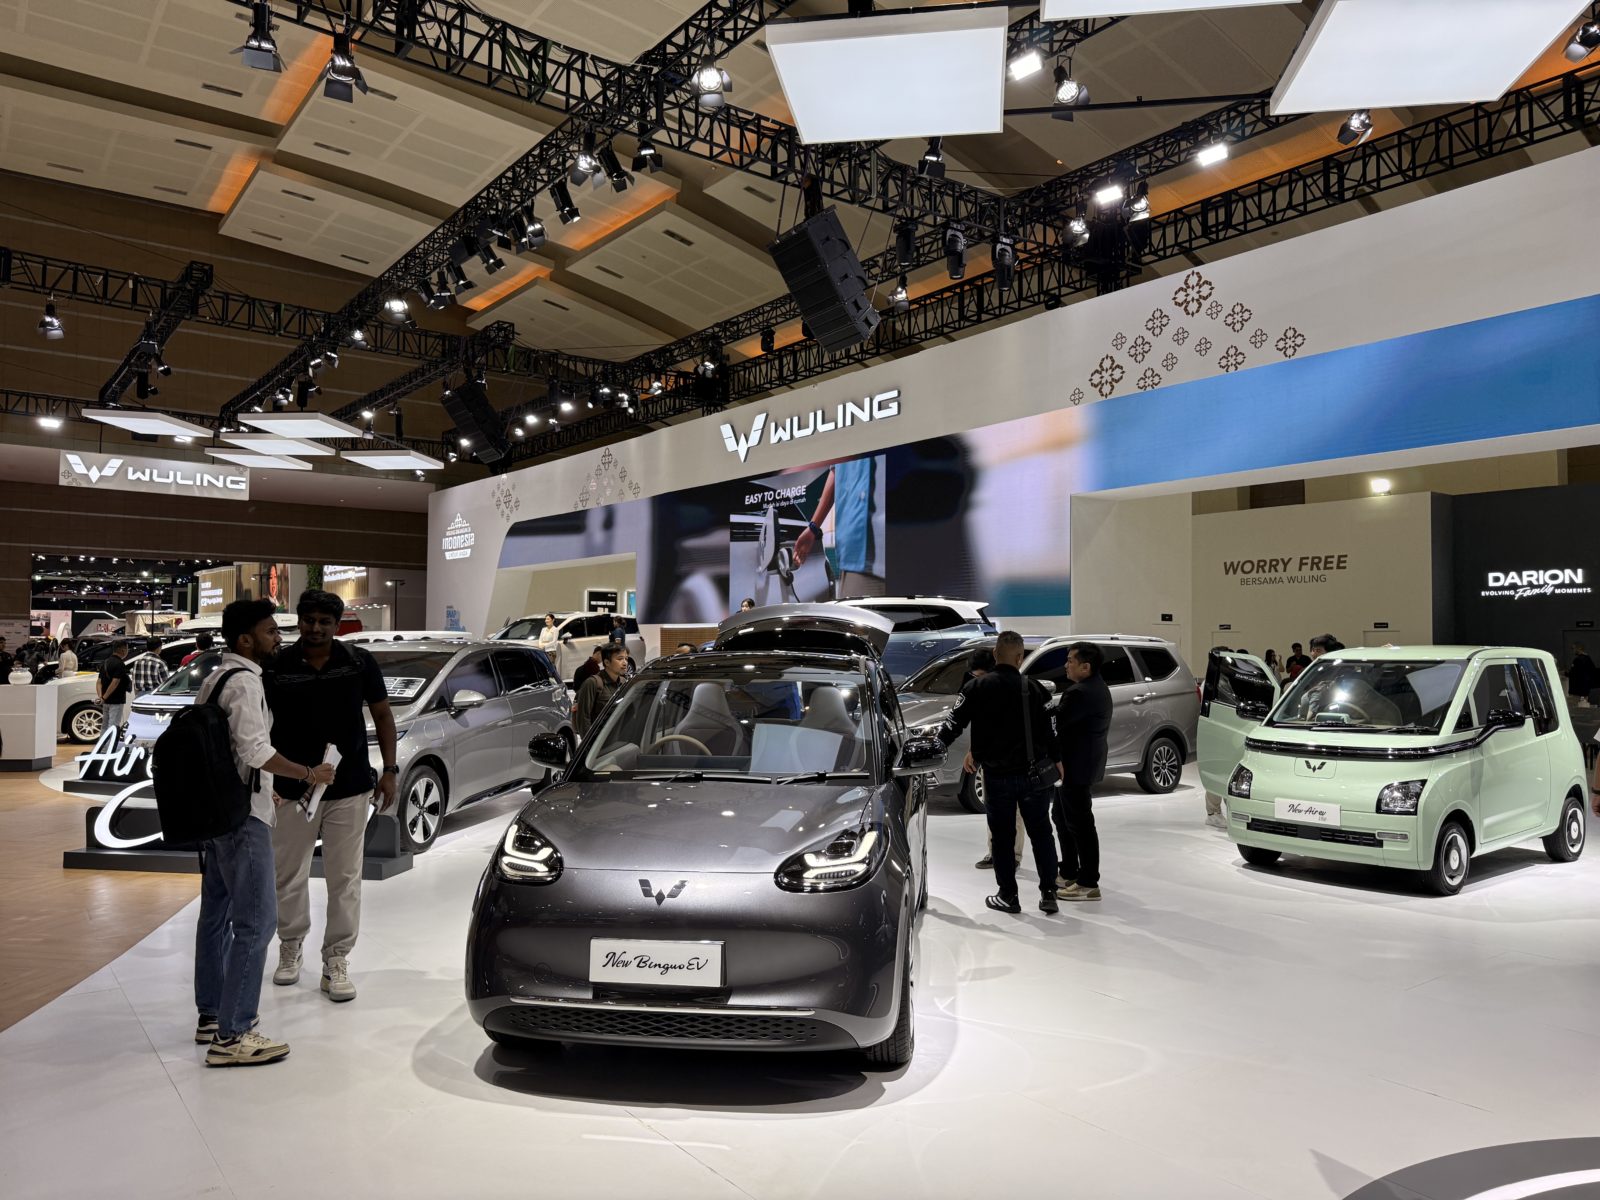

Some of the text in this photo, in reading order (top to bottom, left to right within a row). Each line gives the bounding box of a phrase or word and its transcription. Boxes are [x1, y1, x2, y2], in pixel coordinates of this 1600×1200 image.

[770, 389, 899, 444] WULING
[127, 466, 247, 490] WULING
[745, 485, 807, 504] EASY TO CHARGE
[1223, 554, 1348, 575] WORRY FREE
[1240, 574, 1327, 586] BERSAMA WULING
[1488, 568, 1583, 587] DARION
[1514, 583, 1554, 600] Family
[75, 725, 145, 779] Air
[1287, 803, 1303, 814] New
[1304, 806, 1318, 815] Air
[602, 951, 709, 975] New Binguo EV
